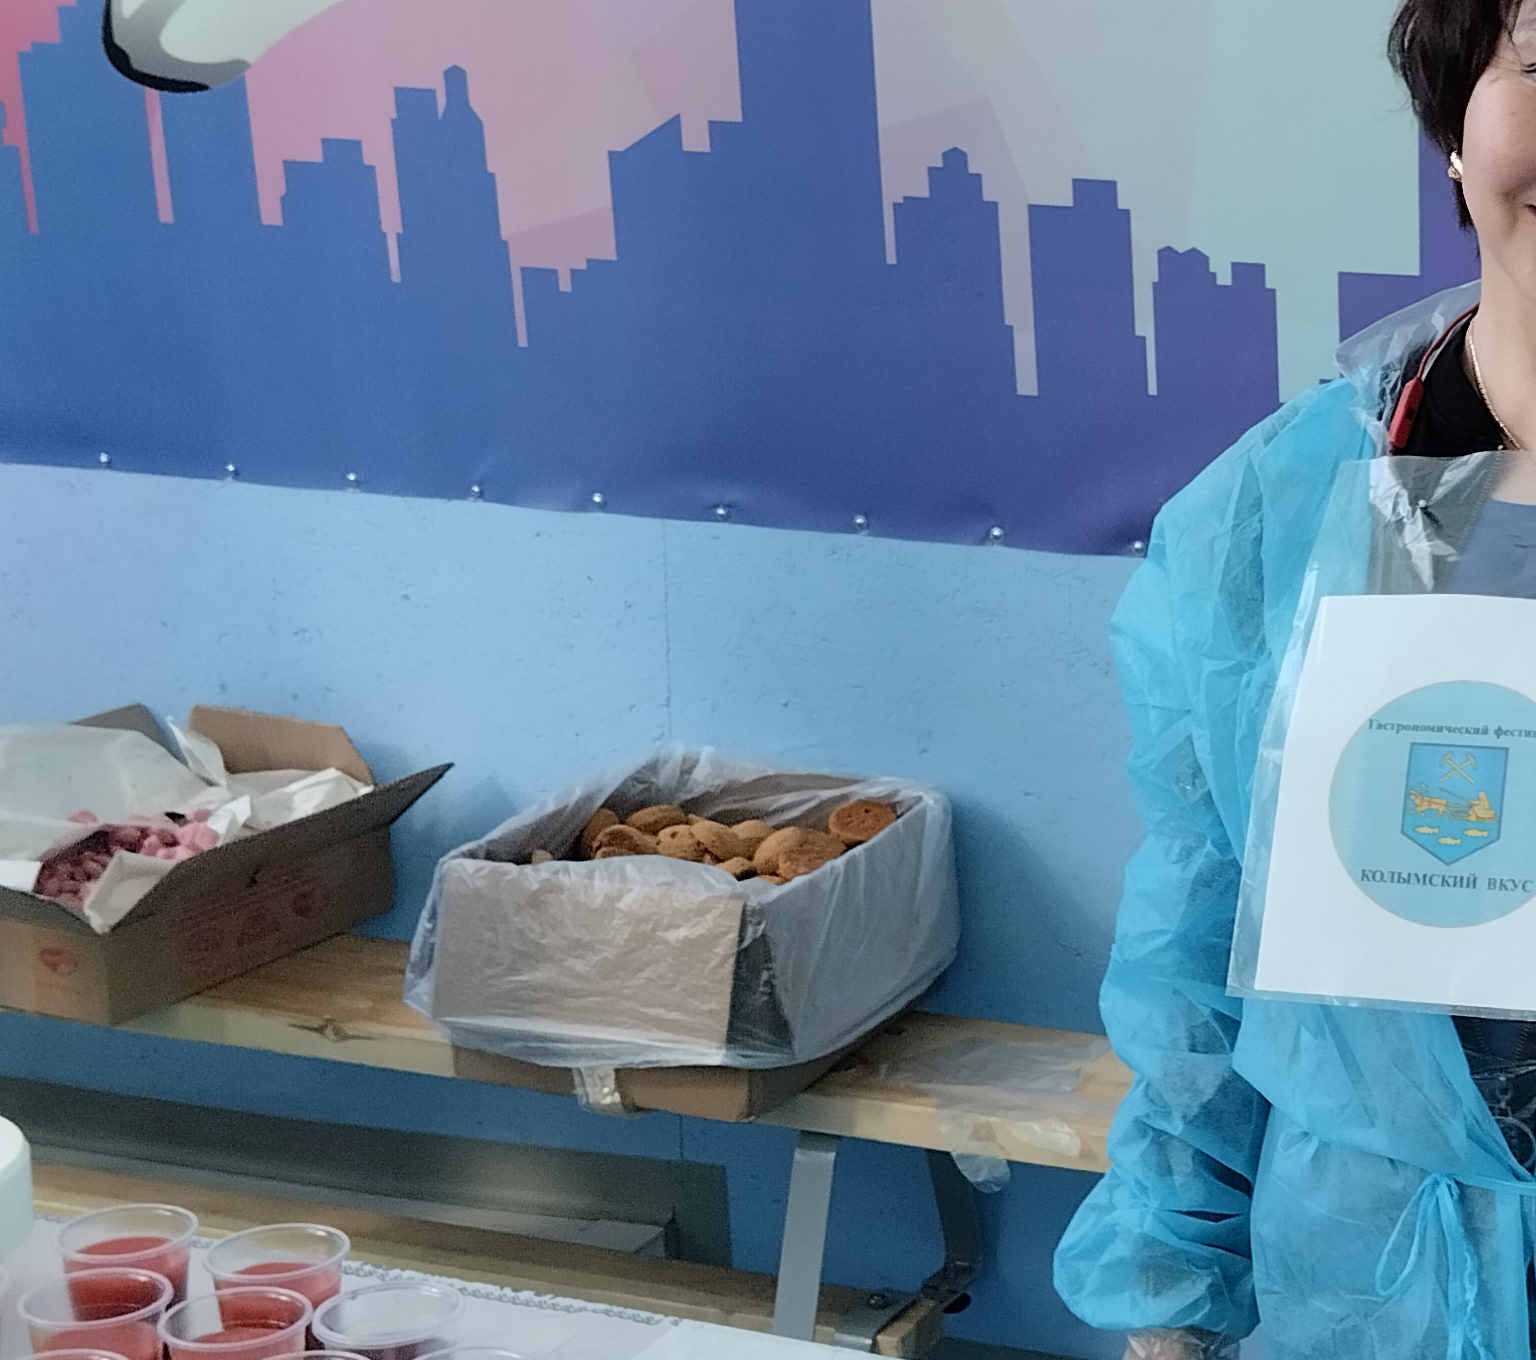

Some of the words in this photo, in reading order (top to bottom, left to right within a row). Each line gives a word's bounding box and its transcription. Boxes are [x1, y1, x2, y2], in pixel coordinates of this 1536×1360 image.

[1368, 717, 1490, 737] Гастрономический
[1360, 868, 1478, 890] КОЛЫМСКИЙ
[1486, 877, 1534, 893] ВКУС
